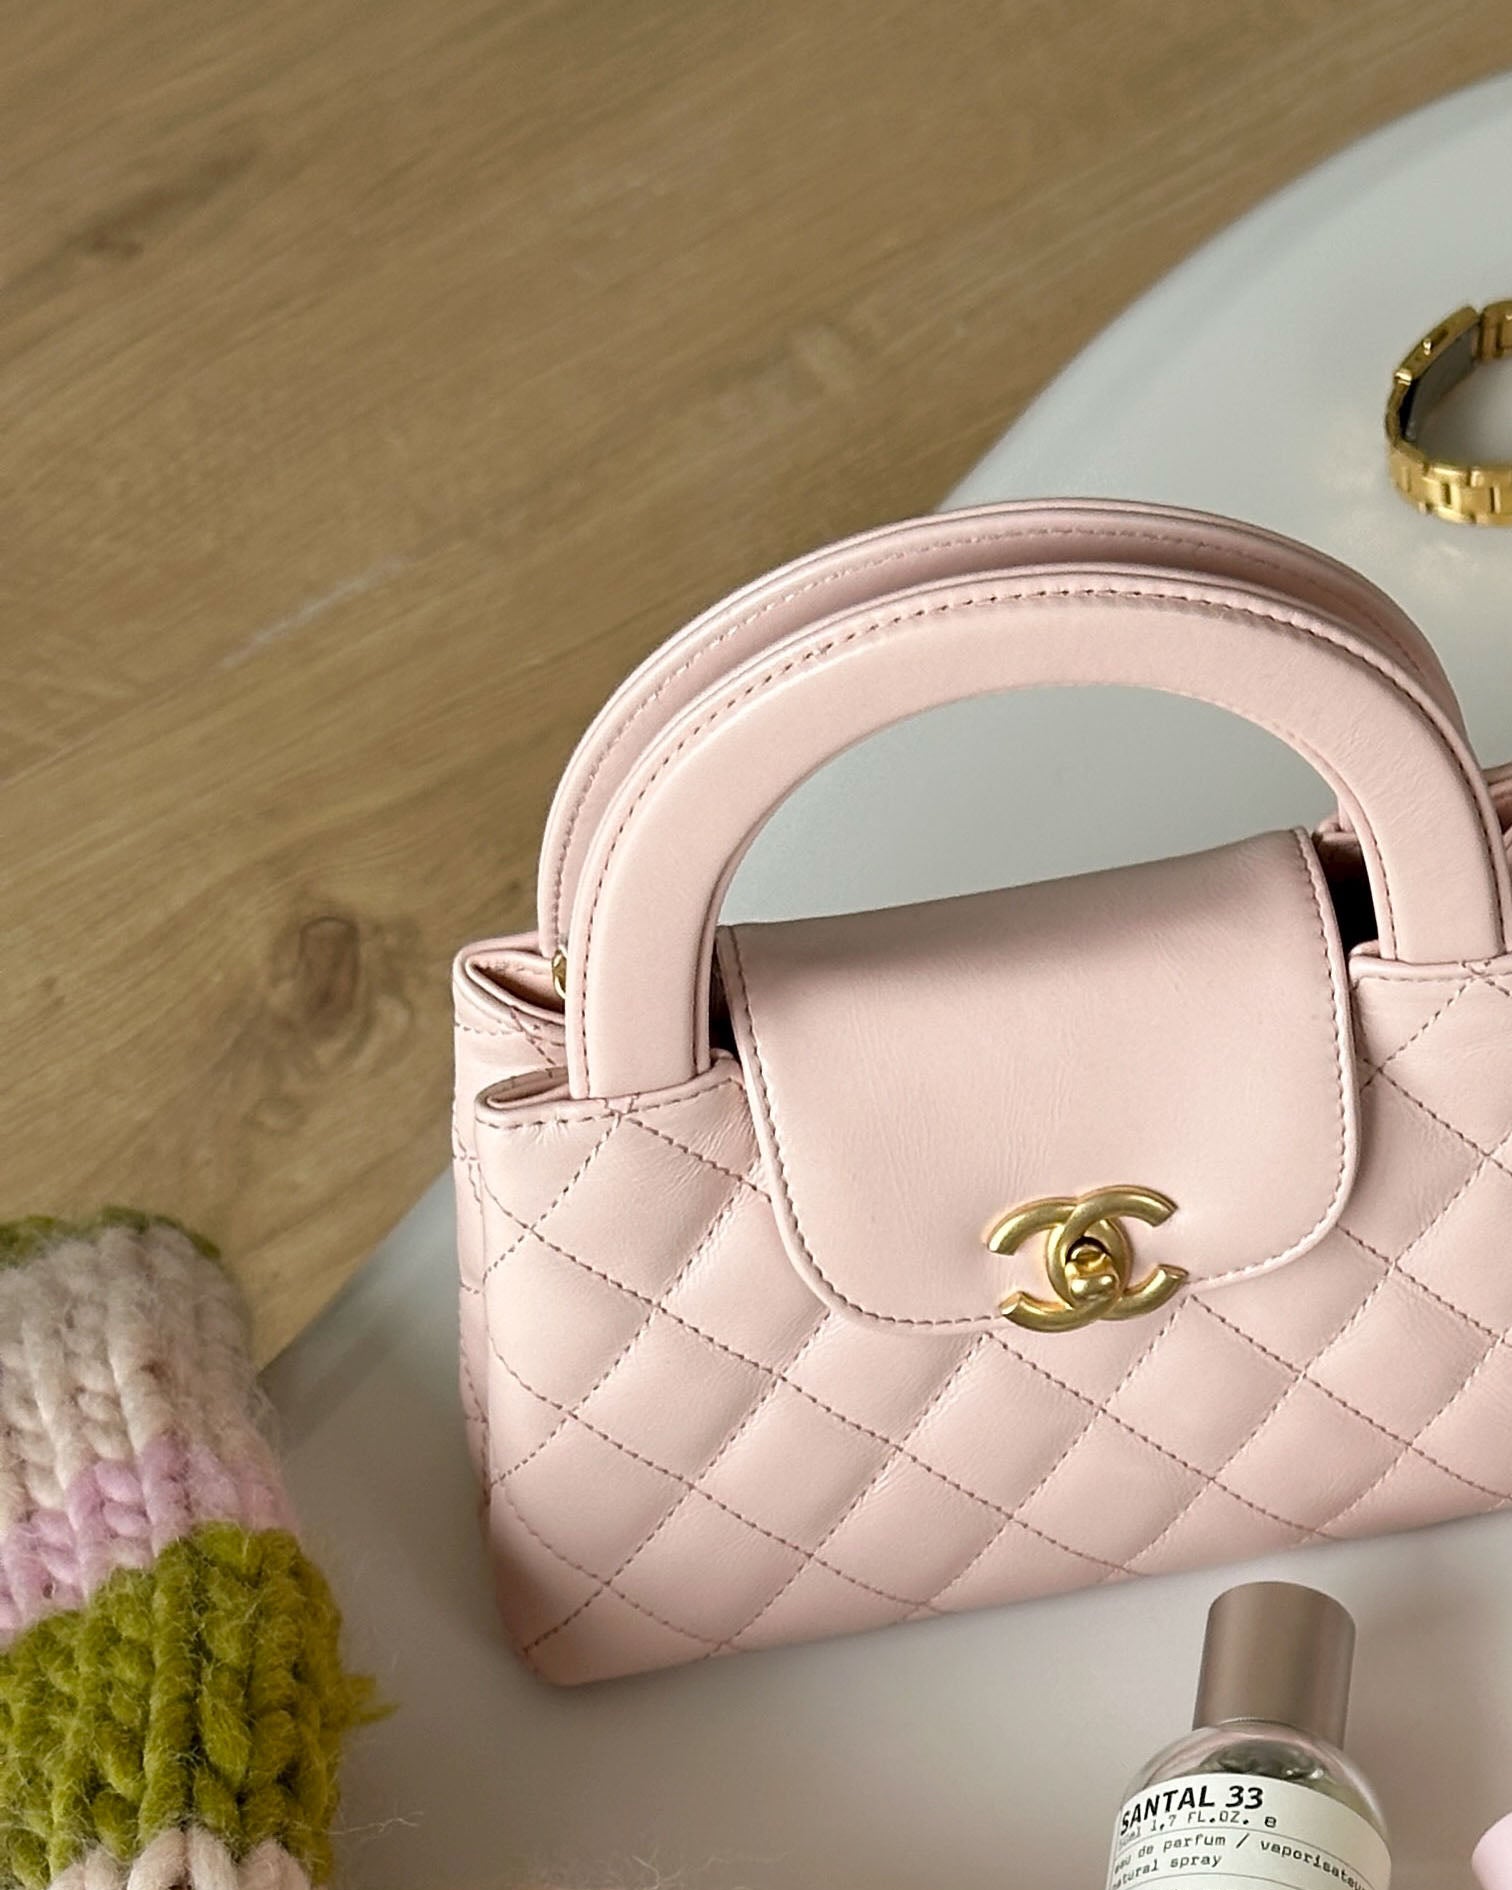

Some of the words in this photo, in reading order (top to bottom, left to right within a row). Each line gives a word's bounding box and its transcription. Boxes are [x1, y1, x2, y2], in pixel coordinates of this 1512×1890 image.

[1120, 1784, 1215, 1837] SANTAL
[1225, 1784, 1264, 1810] 33
[1138, 1845, 1154, 1859] de
[1163, 1833, 1227, 1853] parfum
[1236, 1833, 1250, 1849] /
[1170, 1854, 1223, 1869] spray
